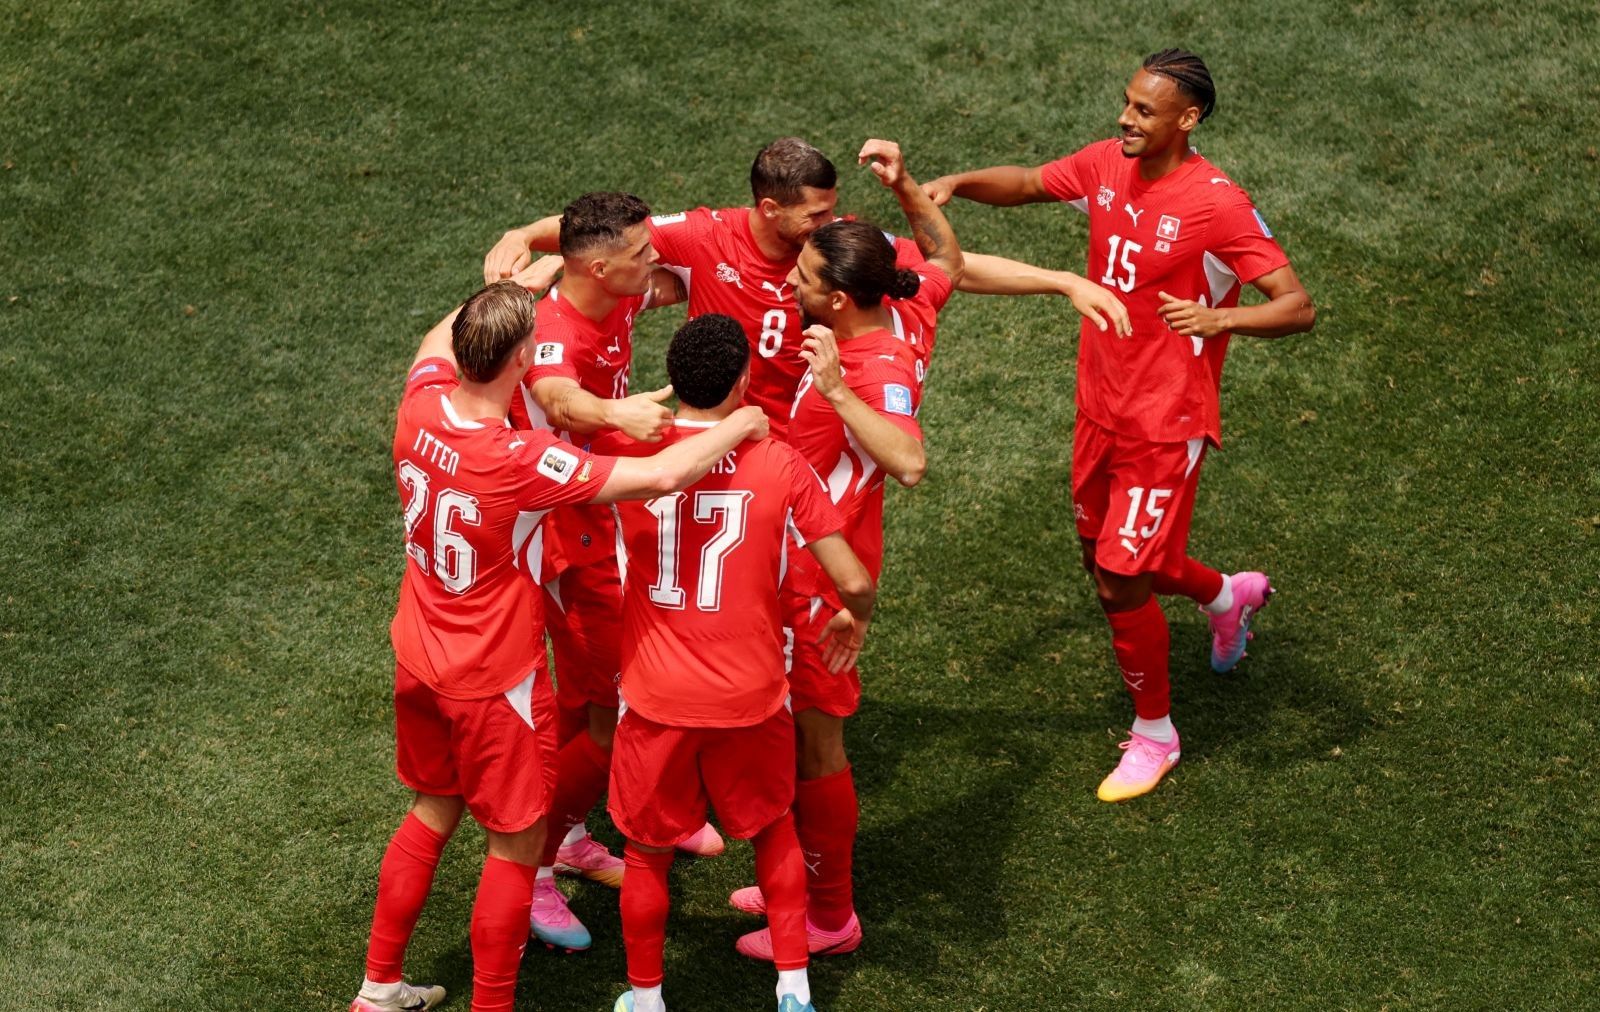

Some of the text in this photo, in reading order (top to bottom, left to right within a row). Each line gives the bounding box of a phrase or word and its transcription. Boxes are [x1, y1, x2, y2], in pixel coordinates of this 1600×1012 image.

[1101, 234, 1143, 294] 15
[758, 309, 787, 358] 8
[413, 429, 460, 477] ITTEN
[399, 459, 481, 595] 26
[1118, 486, 1173, 540] 15
[644, 490, 755, 612] 17
